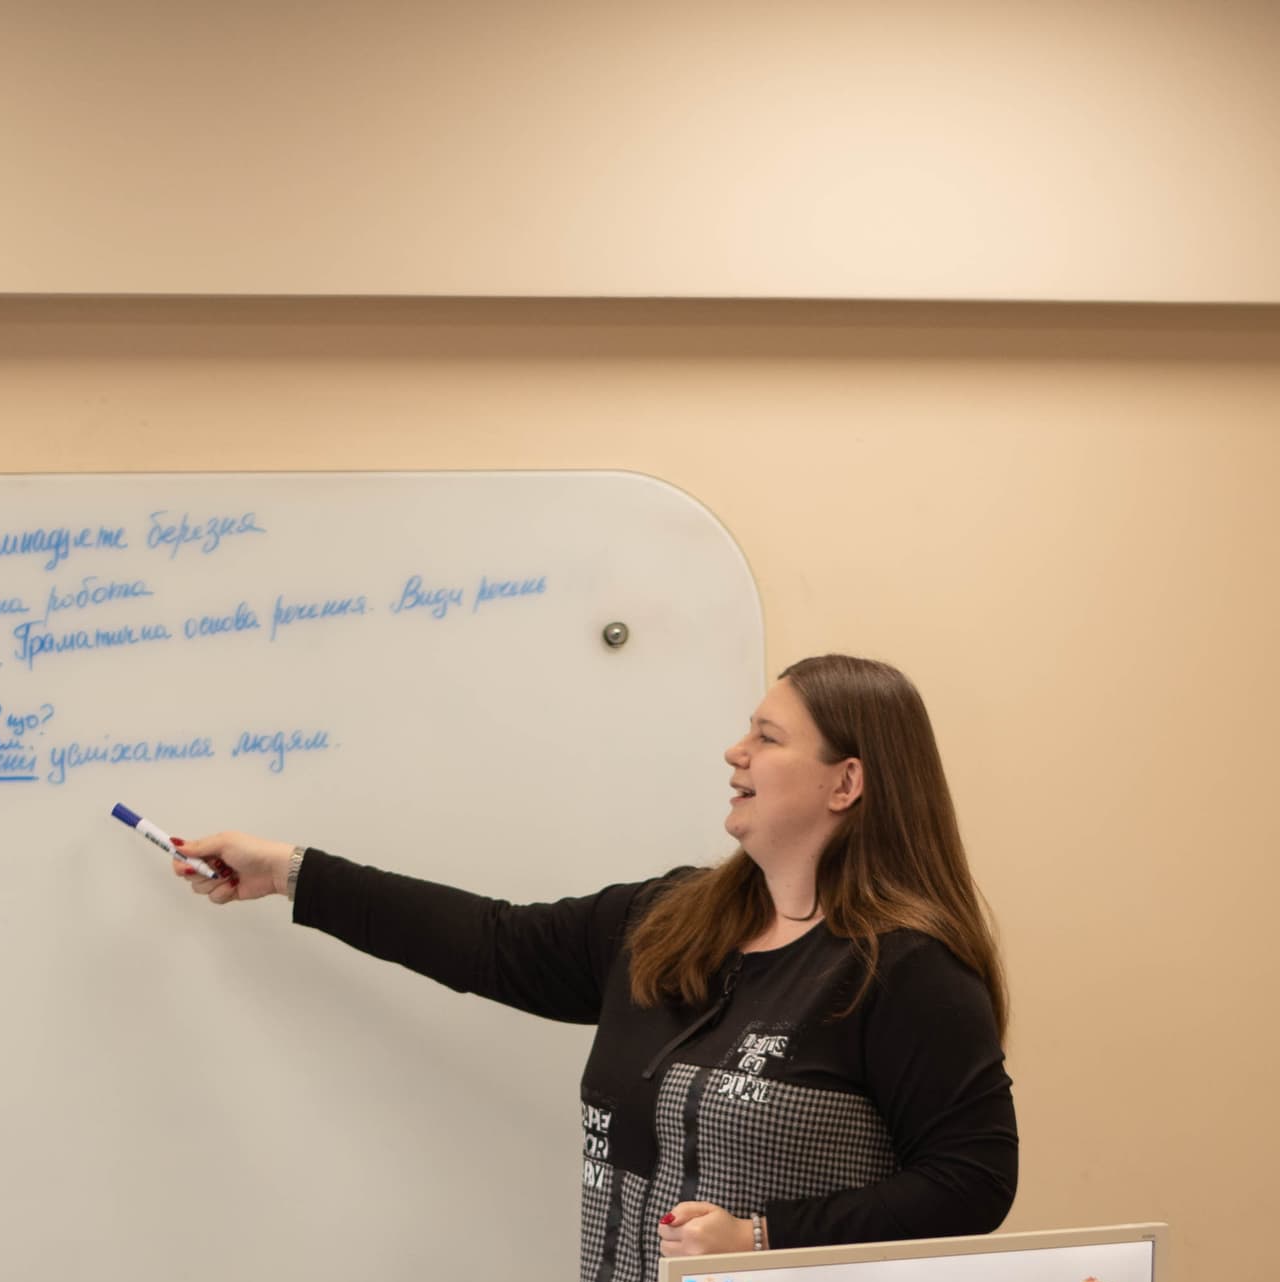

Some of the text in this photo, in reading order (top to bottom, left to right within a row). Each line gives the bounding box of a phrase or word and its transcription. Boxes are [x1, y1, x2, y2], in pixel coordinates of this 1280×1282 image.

[146, 510, 266, 559] березня
[12, 618, 172, 671] Граматична
[183, 601, 260, 640] основа
[389, 574, 463, 619] Види
[43, 575, 154, 625] робота
